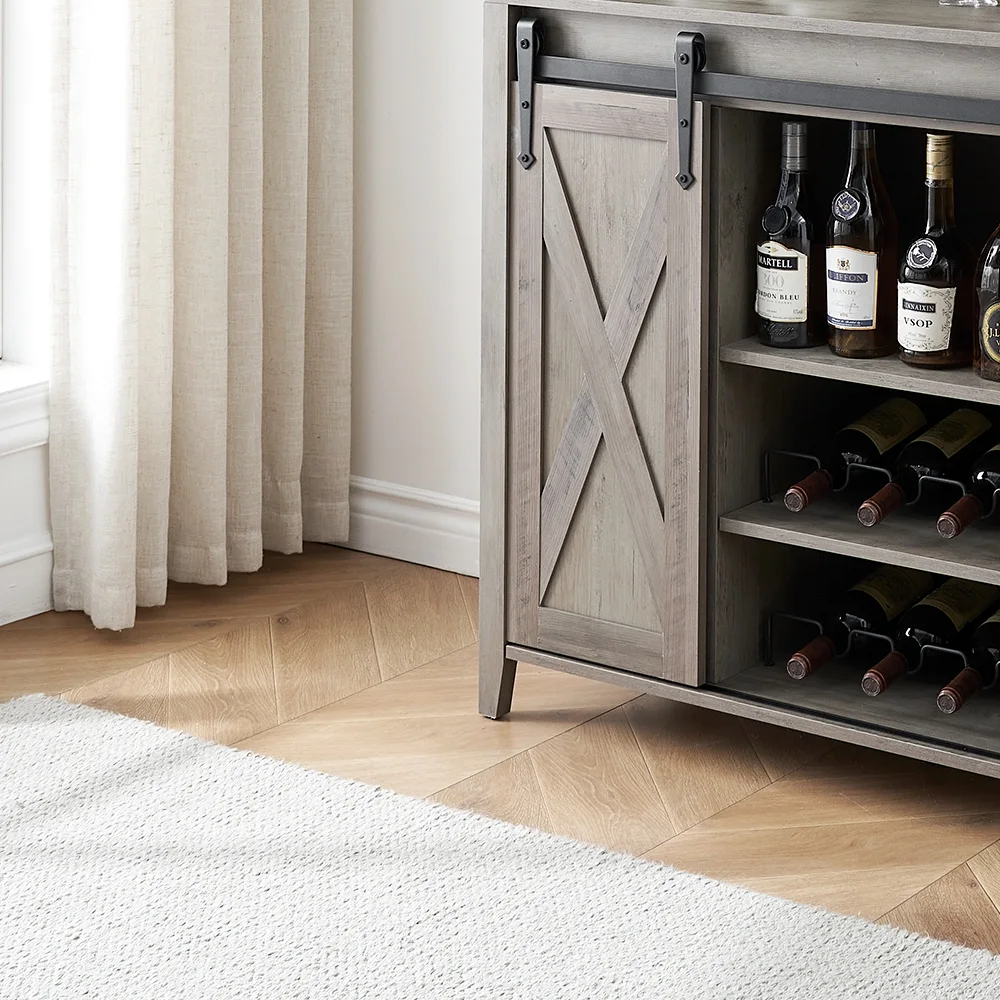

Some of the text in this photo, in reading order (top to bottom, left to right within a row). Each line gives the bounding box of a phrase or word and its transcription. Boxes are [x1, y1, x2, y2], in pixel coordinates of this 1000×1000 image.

[758, 255, 793, 269] MARTELL
[763, 273, 785, 289] 300
[903, 316, 933, 328] VSOP
